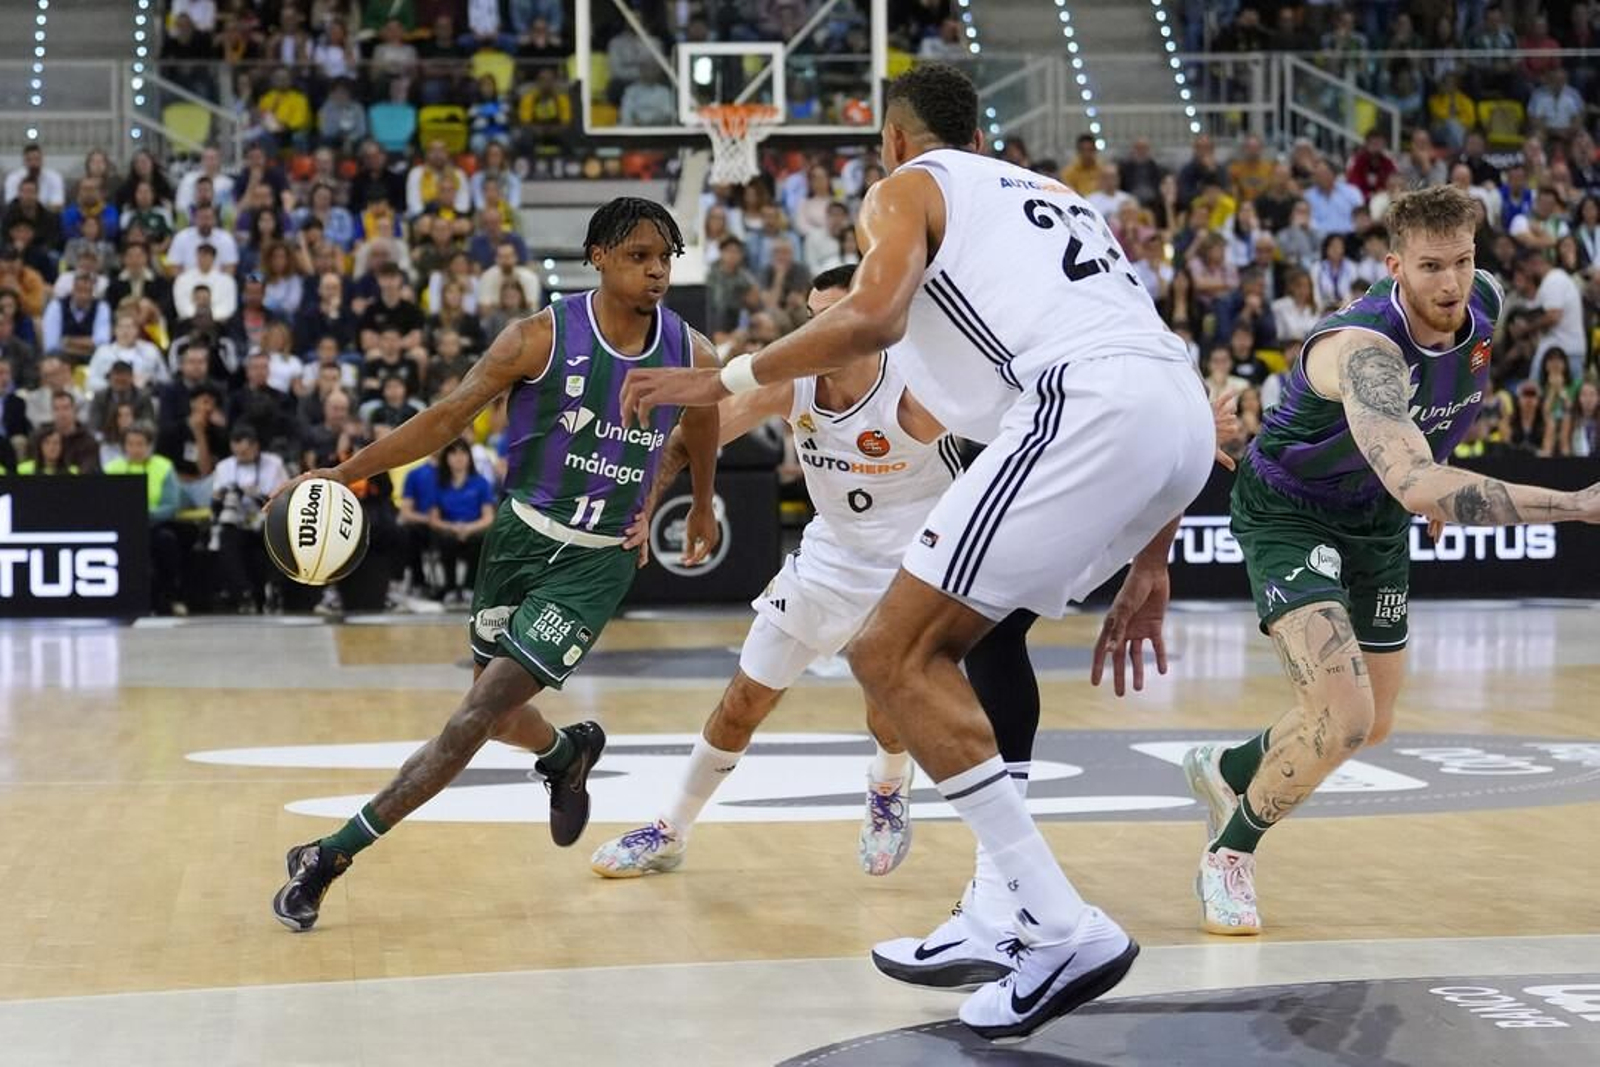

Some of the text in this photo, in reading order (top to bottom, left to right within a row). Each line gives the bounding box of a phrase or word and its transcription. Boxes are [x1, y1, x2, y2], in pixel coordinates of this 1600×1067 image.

[594, 419, 665, 451] Unicaja
[564, 452, 645, 485] málaga
[802, 453, 907, 475] AUTOHERO
[299, 484, 324, 548] Wilson
[569, 495, 606, 531] 11
[848, 488, 873, 513] 0
[1409, 524, 1557, 561] LOTUS
